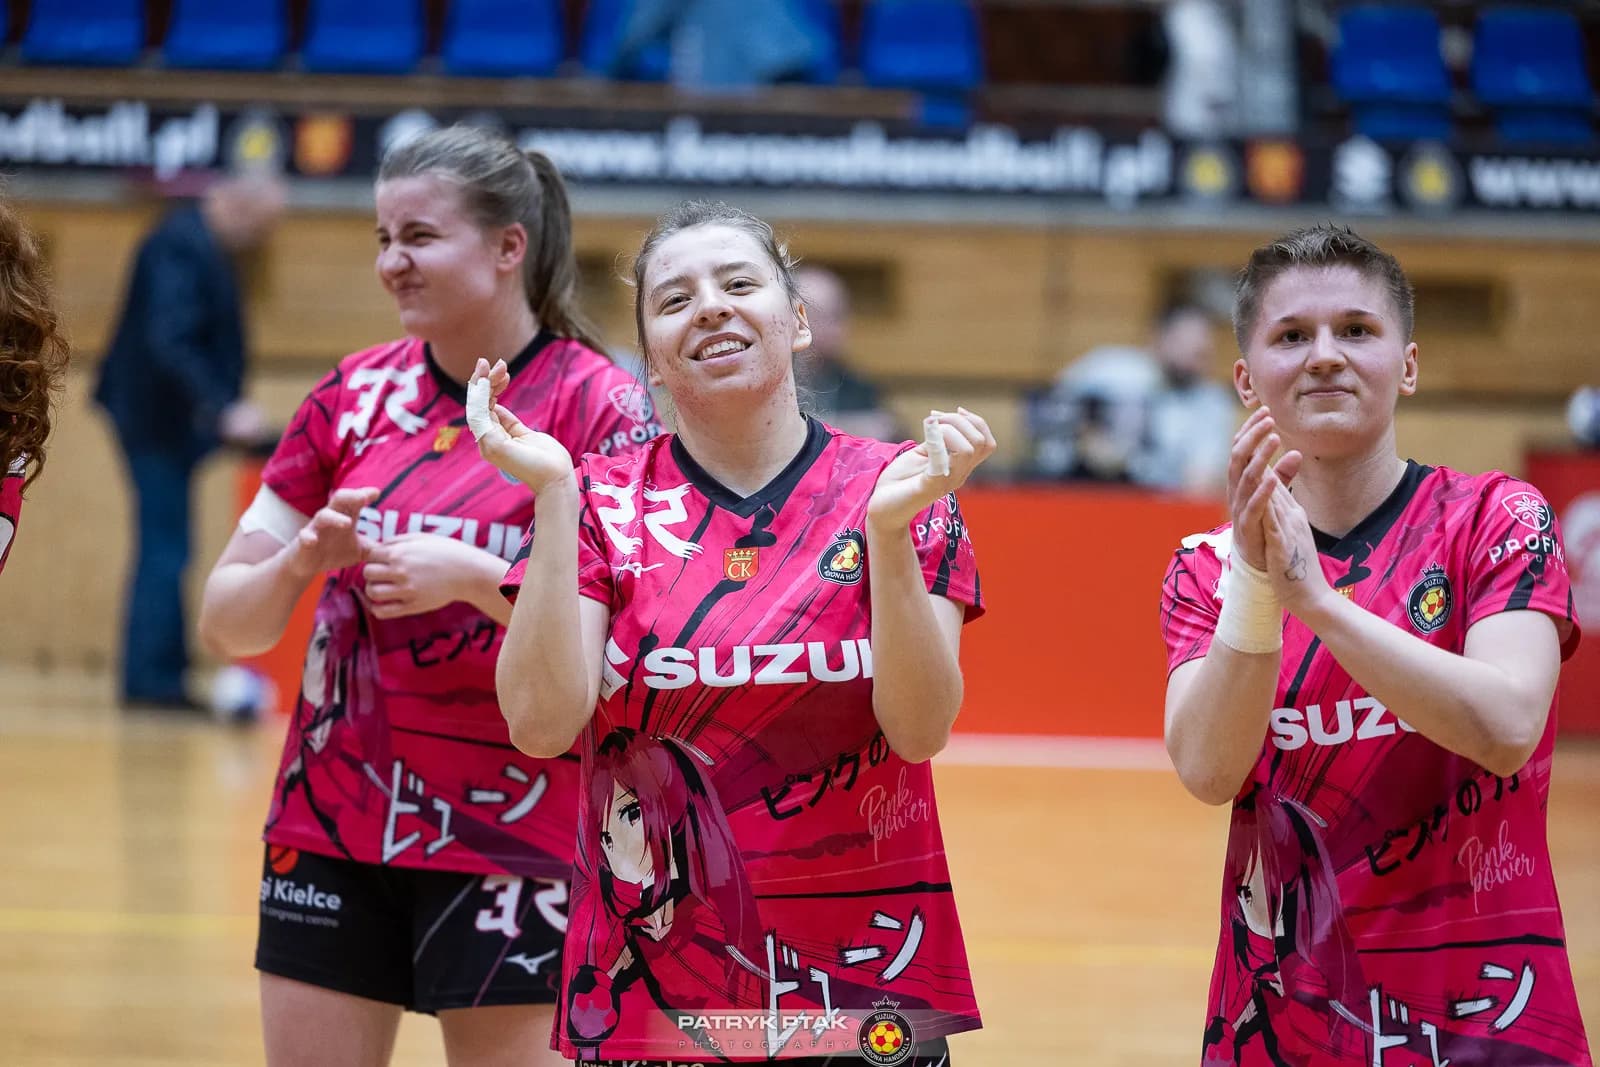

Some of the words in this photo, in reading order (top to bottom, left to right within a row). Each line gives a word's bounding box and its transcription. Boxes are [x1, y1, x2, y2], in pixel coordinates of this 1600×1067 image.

[727, 562, 752, 580] CK
[859, 766, 912, 835] Pink
[873, 798, 930, 863] power
[1458, 820, 1516, 886] Pink
[1472, 853, 1535, 914] power
[274, 879, 342, 911] Kielce
